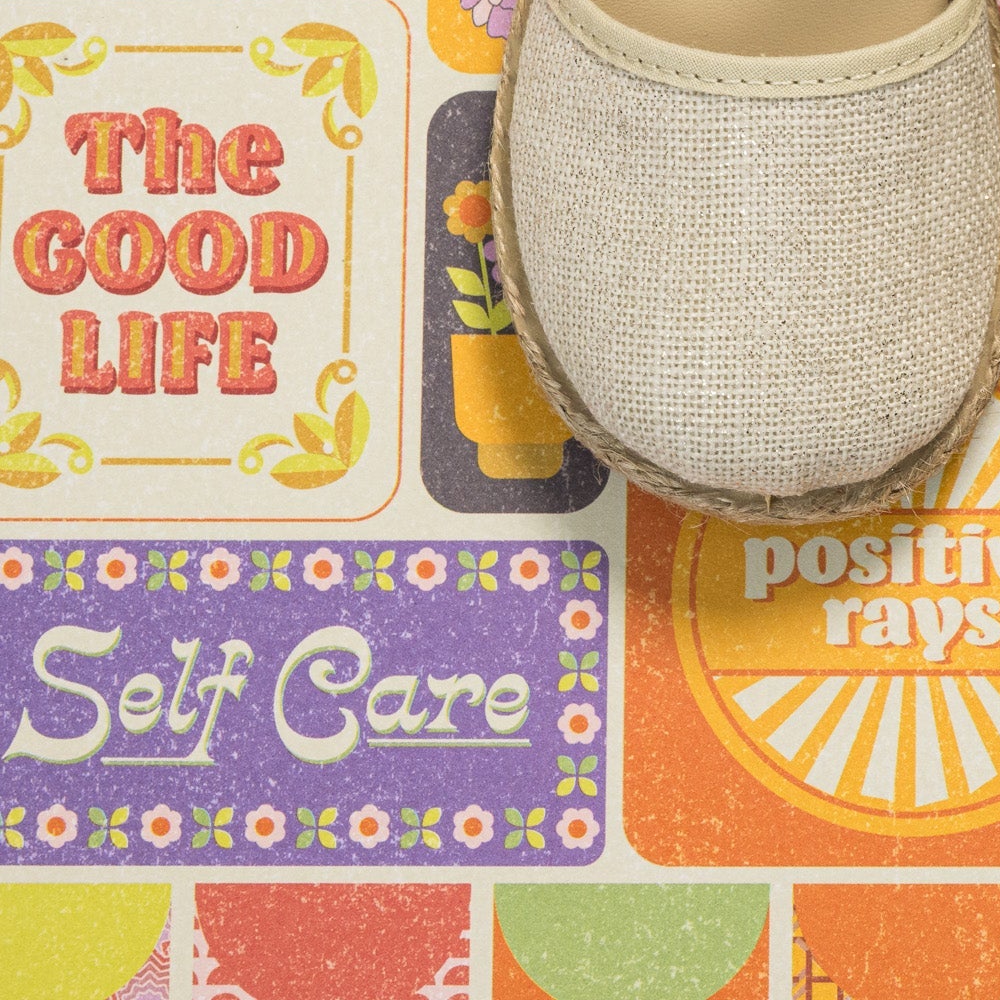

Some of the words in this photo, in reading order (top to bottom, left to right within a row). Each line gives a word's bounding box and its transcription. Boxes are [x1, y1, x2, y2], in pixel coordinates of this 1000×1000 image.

[64, 107, 285, 196] The
[13, 209, 330, 297] GOOD
[60, 309, 278, 396] LIFE
[2, 625, 254, 766] Self
[273, 627, 532, 764] Care
